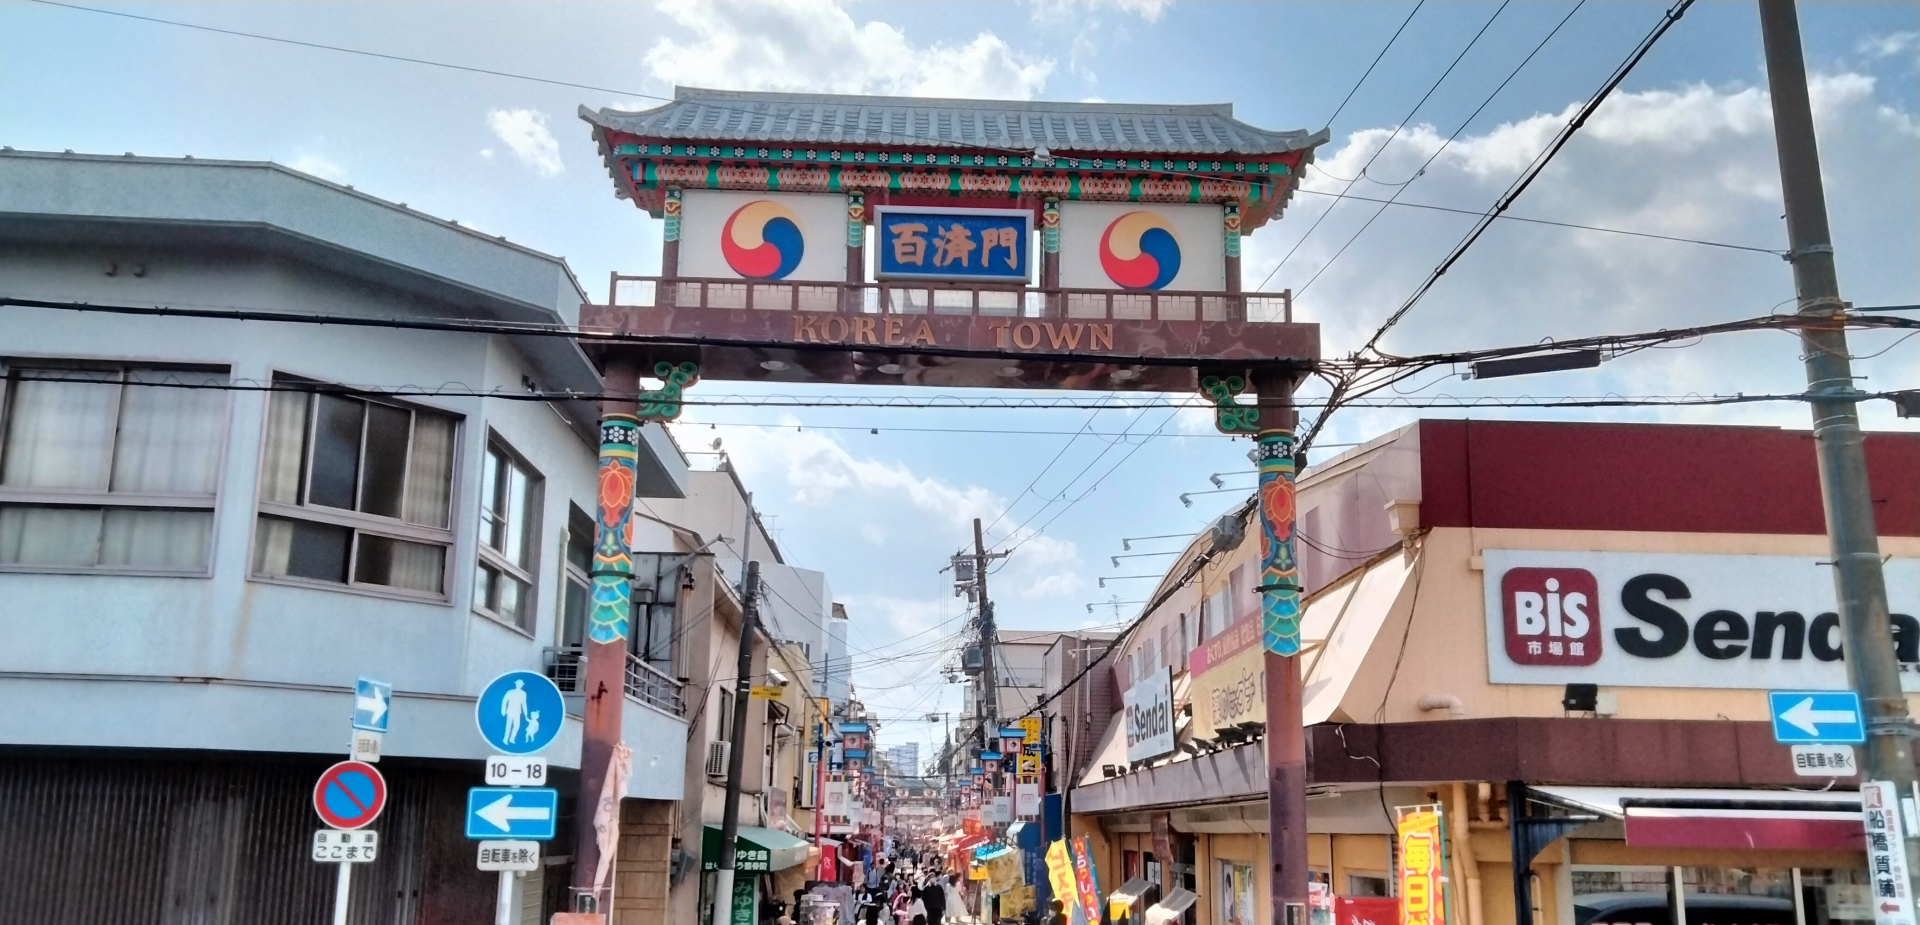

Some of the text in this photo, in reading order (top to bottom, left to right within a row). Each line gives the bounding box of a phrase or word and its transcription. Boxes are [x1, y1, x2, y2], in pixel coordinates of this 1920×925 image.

[889, 222, 1018, 270] 百済門
[792, 315, 1114, 351] KOREA TOWN
[1527, 641, 1585, 656] 市場館
[1135, 683, 1168, 743] Sendai
[1796, 752, 1853, 768] 自転車を除く
[318, 833, 375, 843] 自動車
[315, 846, 374, 859] ここまで
[481, 848, 536, 863] 自転車を除く
[734, 881, 753, 925] みゆき
